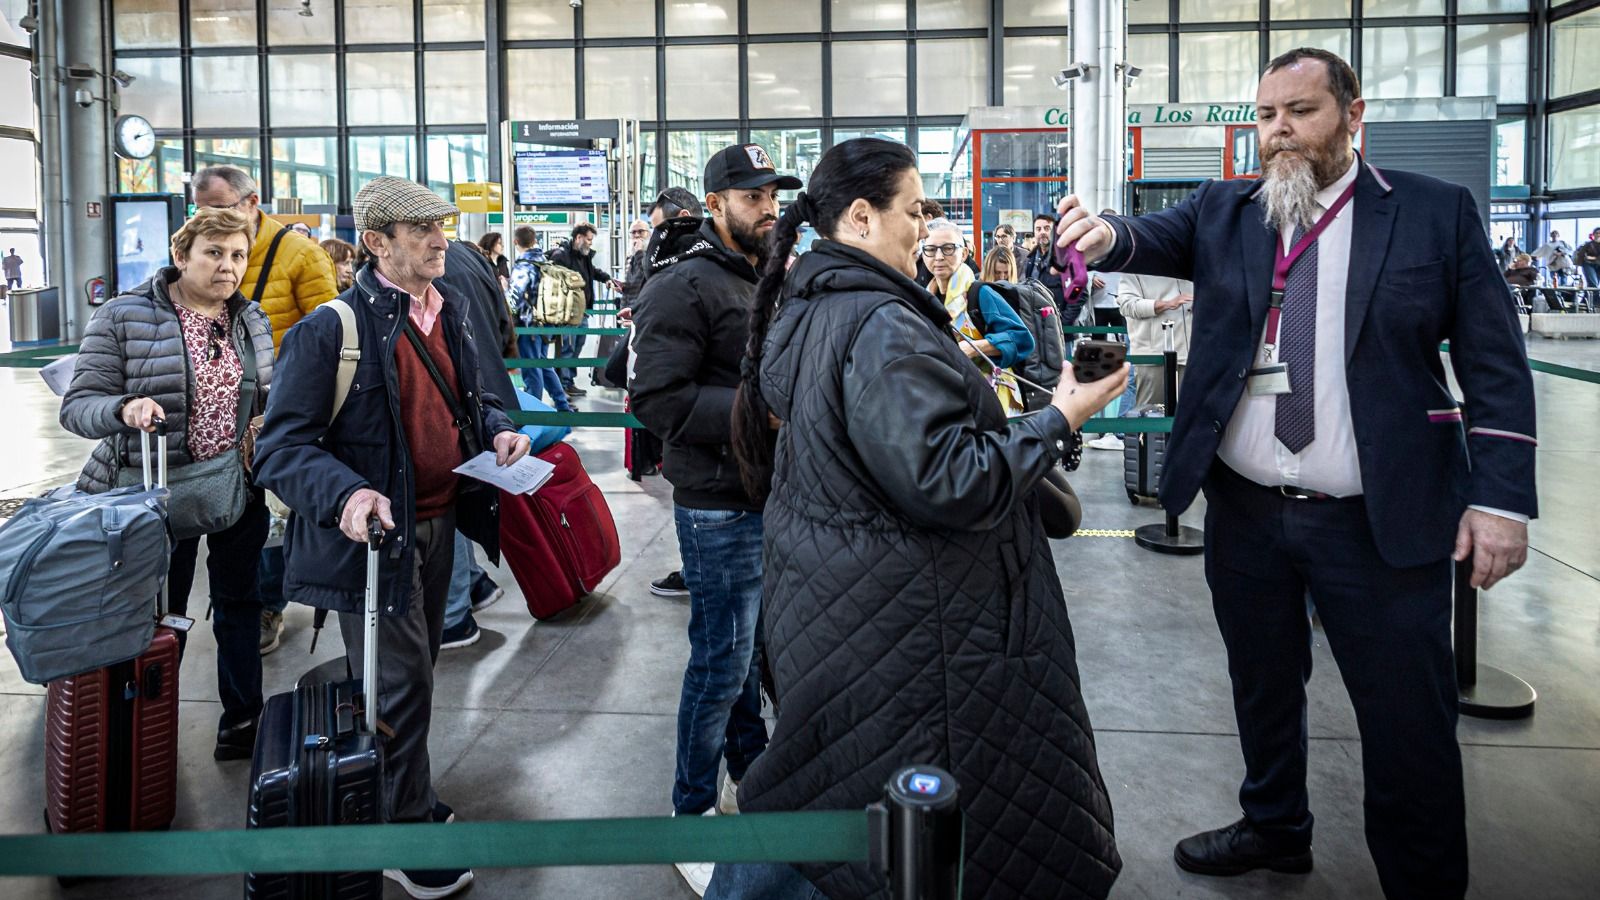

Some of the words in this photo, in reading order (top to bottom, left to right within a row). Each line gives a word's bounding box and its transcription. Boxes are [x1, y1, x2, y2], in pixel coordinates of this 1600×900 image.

[1045, 107, 1068, 125] Ca
[1128, 110, 1141, 124] a
[1155, 105, 1192, 123] Los
[1206, 104, 1257, 122] Raile
[538, 122, 579, 131] Información
[514, 214, 549, 224] uropcar
